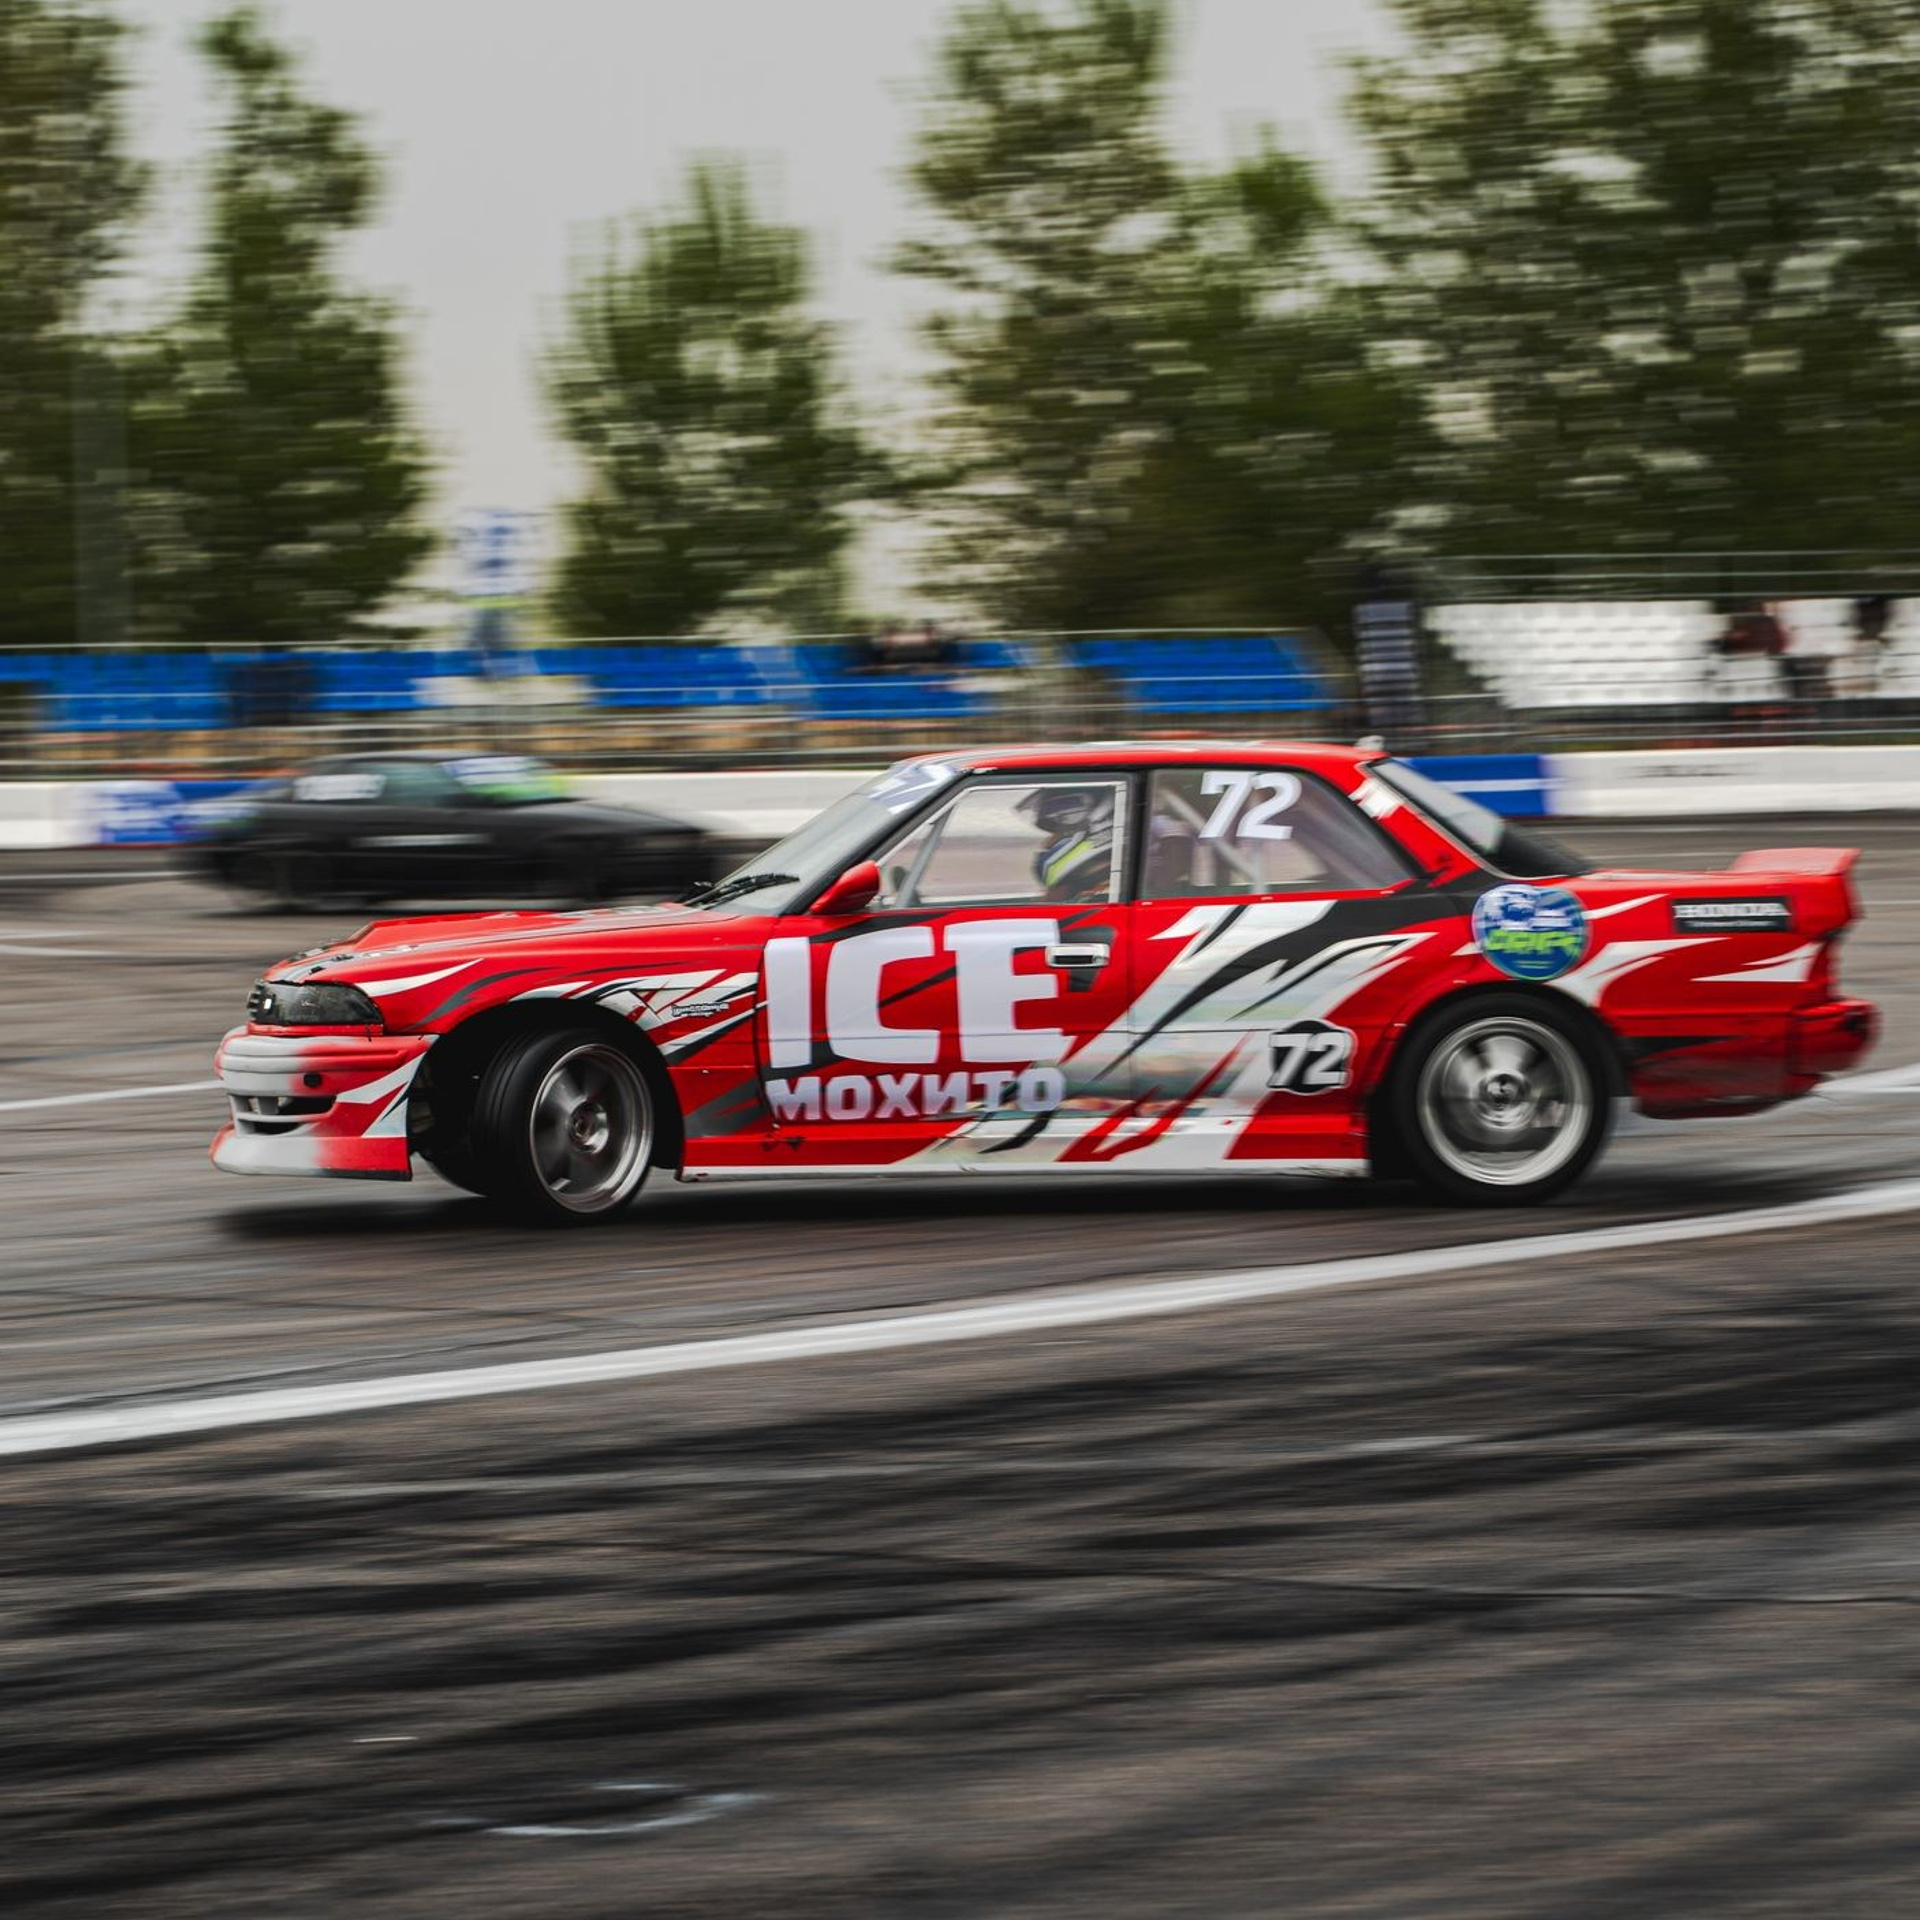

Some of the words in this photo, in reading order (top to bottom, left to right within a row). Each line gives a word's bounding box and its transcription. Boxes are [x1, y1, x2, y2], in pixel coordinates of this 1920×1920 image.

[1198, 770, 1302, 840] 72
[764, 918, 1070, 1069] ICE
[1266, 1031, 1354, 1087] 72
[765, 1066, 1067, 1121] МОХИТО
